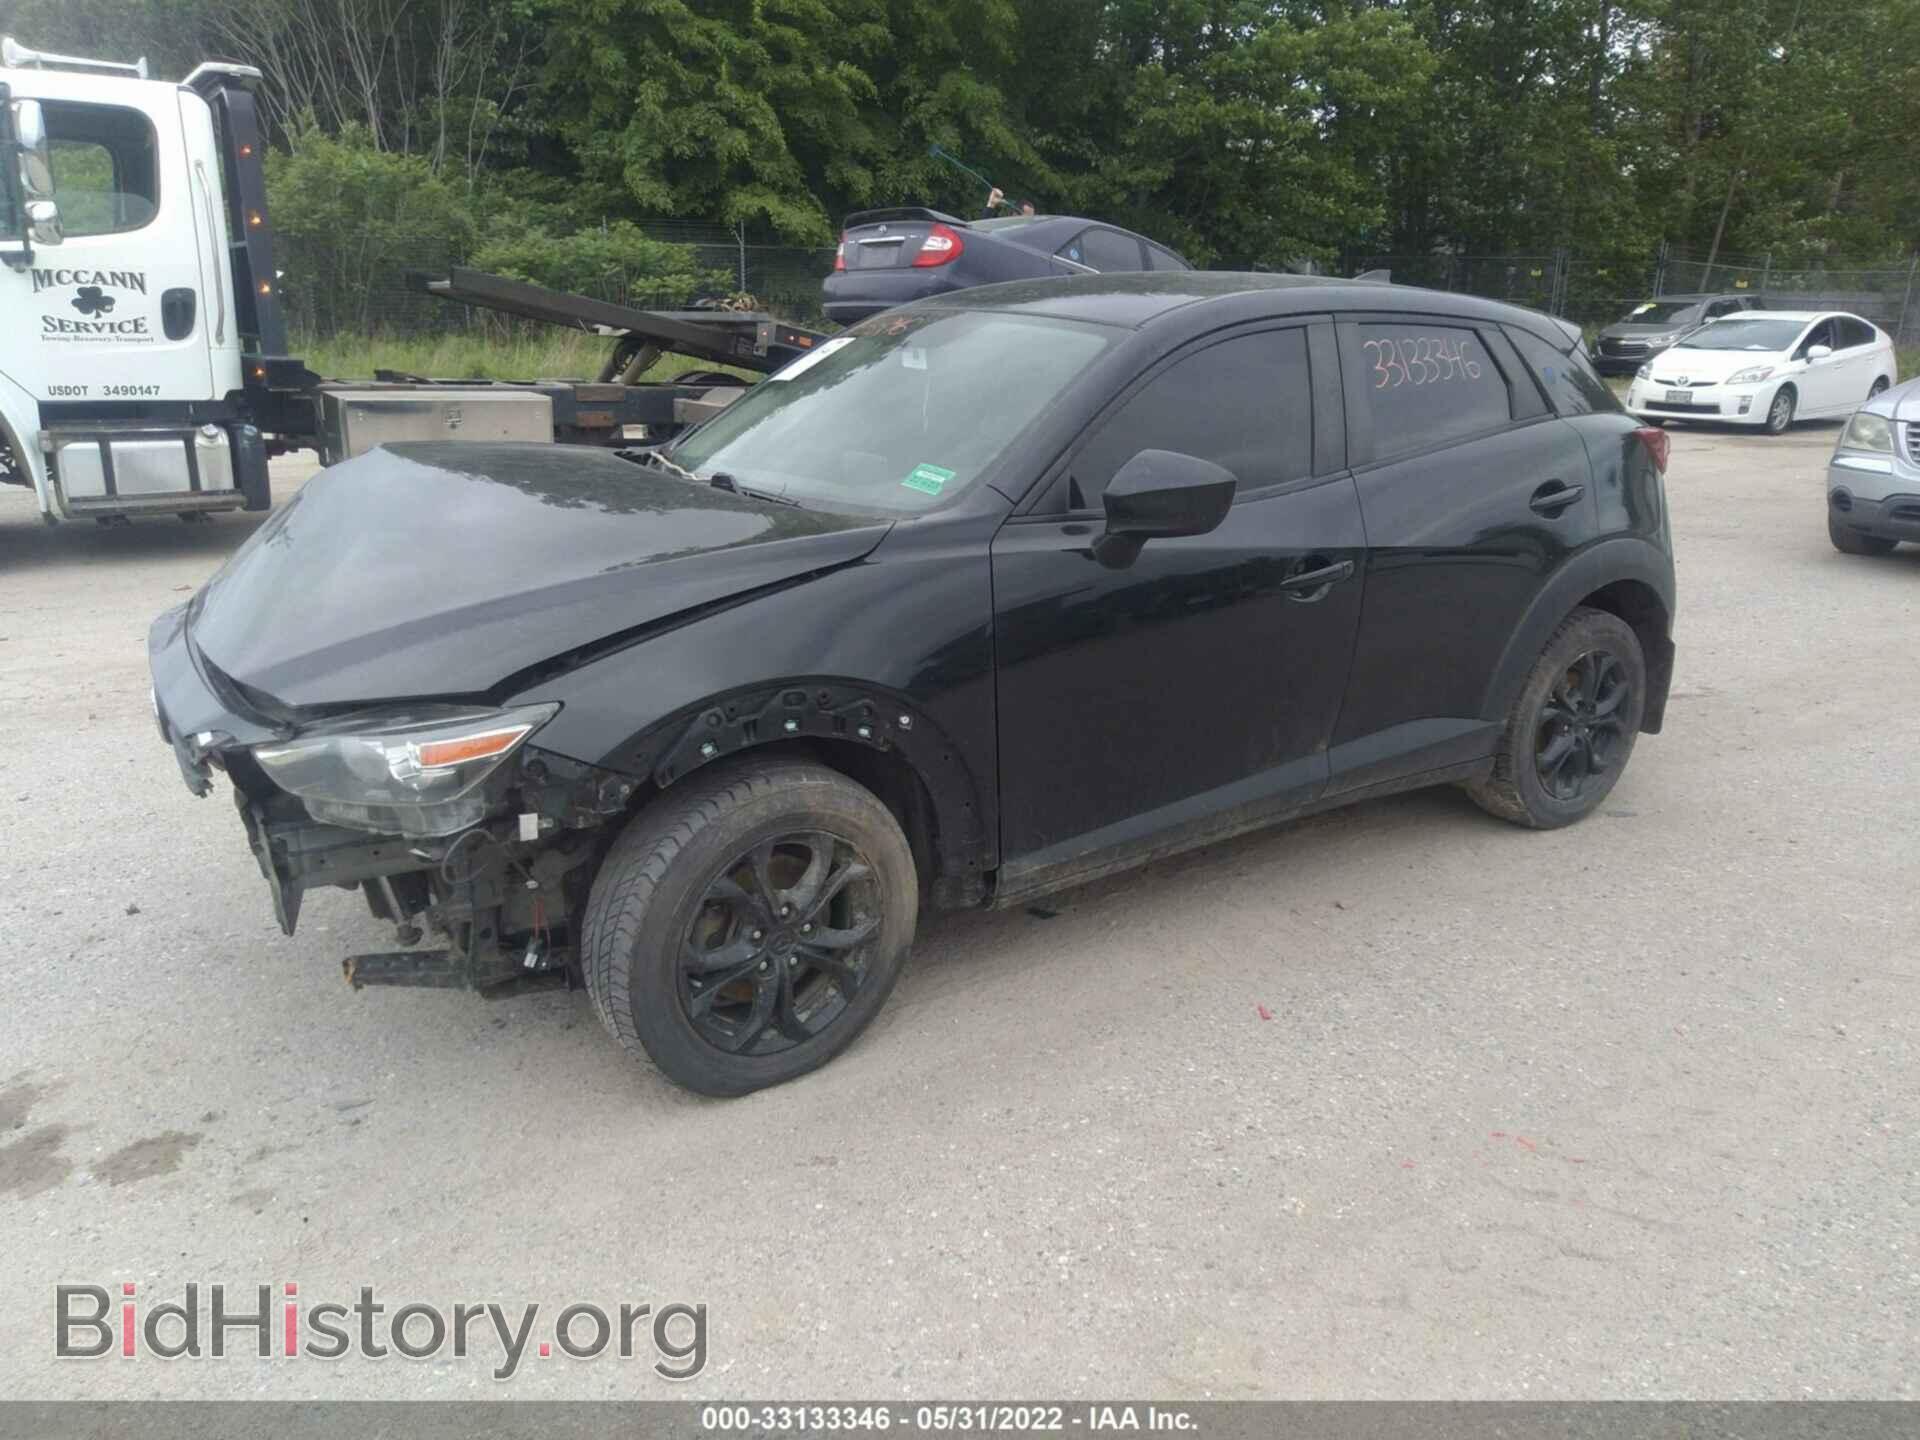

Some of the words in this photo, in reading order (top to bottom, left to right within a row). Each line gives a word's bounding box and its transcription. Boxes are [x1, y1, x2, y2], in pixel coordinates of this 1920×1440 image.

[31, 268, 147, 295] MCCANN
[41, 315, 148, 333] SERVICE
[1363, 338, 1481, 388] 33133346
[48, 385, 89, 396] USDOT
[103, 385, 161, 396] 3490147
